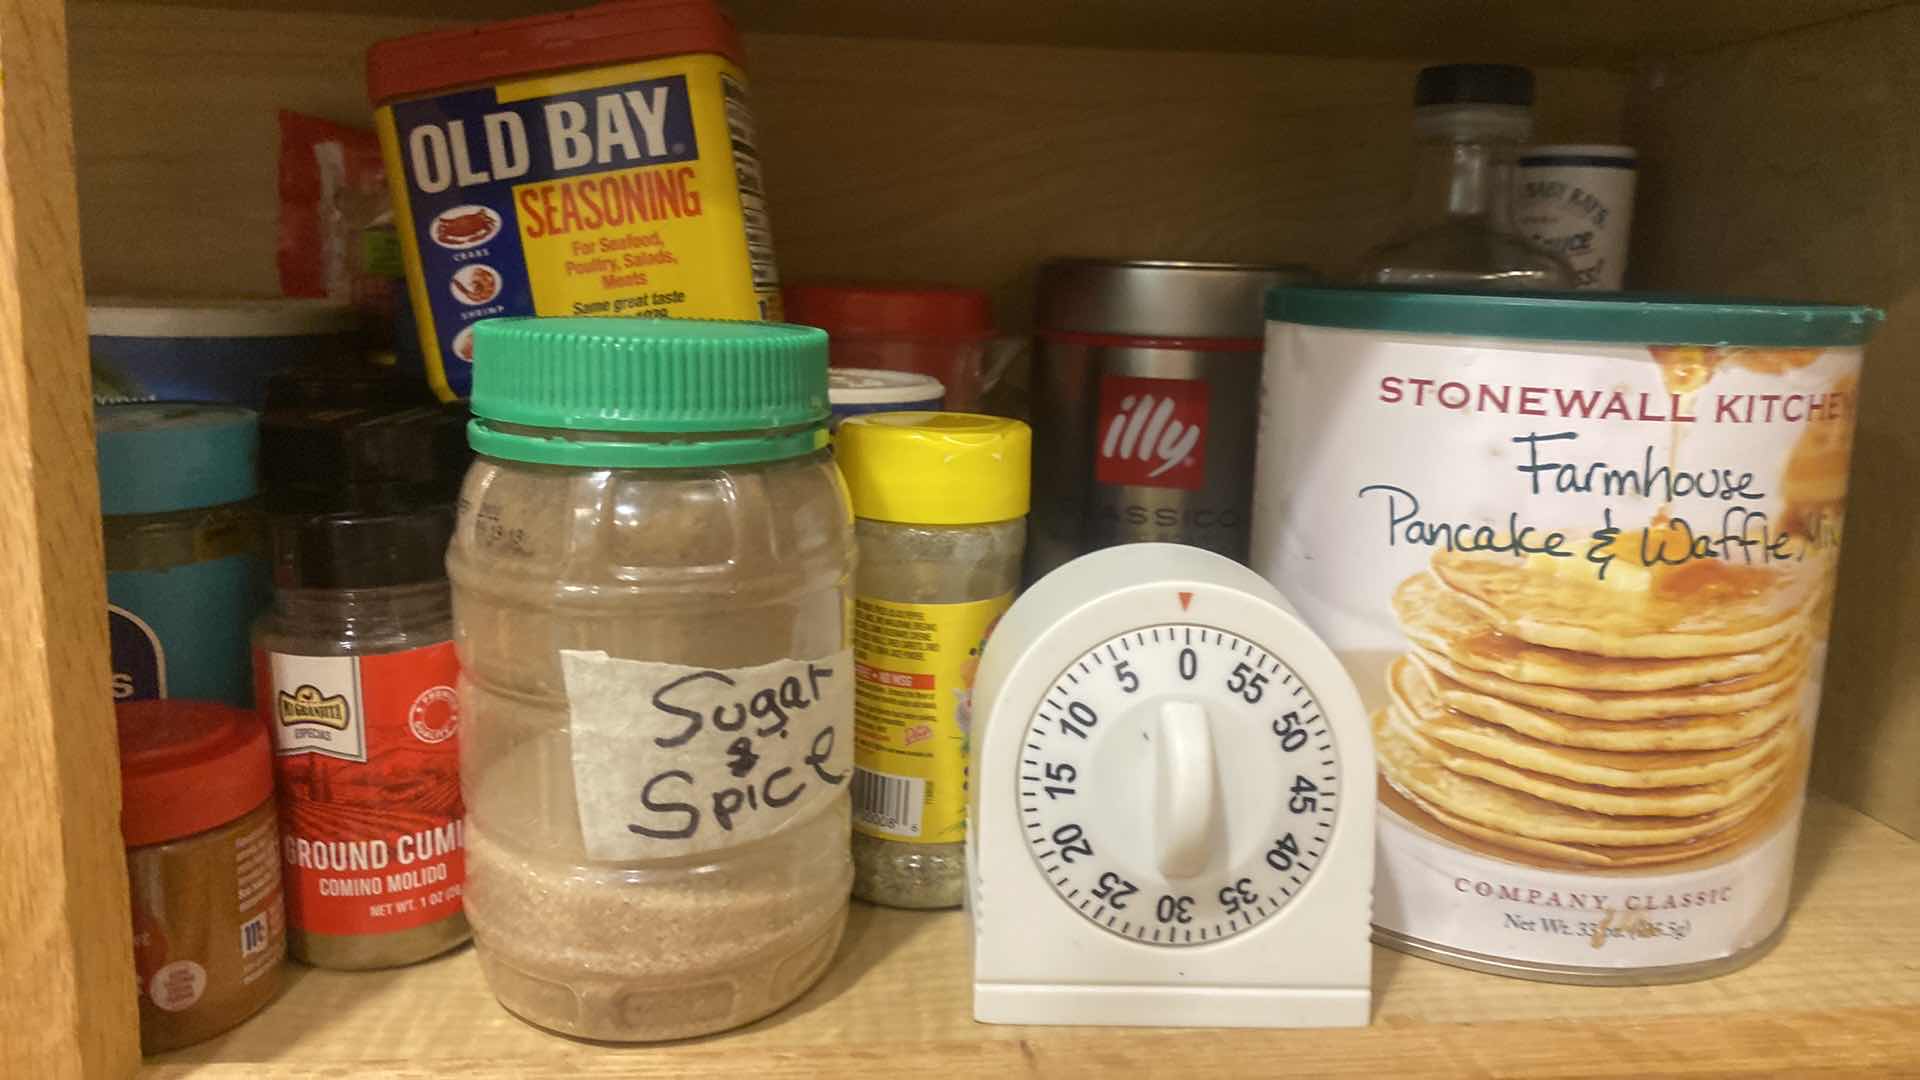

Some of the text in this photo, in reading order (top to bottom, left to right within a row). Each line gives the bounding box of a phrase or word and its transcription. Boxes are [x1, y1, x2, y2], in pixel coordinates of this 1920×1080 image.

[410, 87, 668, 194] OLD BAY
[520, 167, 703, 239] SEASONING
[565, 249, 679, 276] Poultry, Salads,
[572, 232, 665, 257] For Seafood,
[603, 272, 648, 290] Meats
[573, 290, 686, 315] Same great taste
[1381, 377, 1846, 424] STONEWALL KITCHE
[1103, 394, 1200, 478] illy
[1512, 432, 1765, 502] Farmhouse
[1359, 484, 1574, 558] Pancake
[1586, 508, 1617, 581] &
[1641, 506, 1794, 568] Waffle
[1114, 660, 1140, 693] 5
[1179, 648, 1198, 681] 0
[1227, 662, 1269, 704] 55
[652, 664, 833, 748] Sugar
[1059, 701, 1098, 740] 10
[1273, 711, 1308, 752] 50
[726, 736, 760, 778] &
[628, 726, 846, 840] Spice
[1045, 762, 1077, 800] 15
[1289, 775, 1318, 814] 45
[284, 833, 389, 872] GROUND
[396, 819, 464, 865] CUMI
[1052, 823, 1094, 864] 20
[1266, 832, 1299, 871] 40
[319, 863, 448, 897] COMINO MOLIDO
[1091, 871, 1139, 911] 25
[1218, 878, 1258, 915] 35
[1454, 877, 1734, 911] COMPANY CLASSIC
[369, 904, 393, 918] NET
[396, 899, 416, 913] WT.
[421, 896, 427, 909] 1
[429, 891, 444, 906] OZ
[1156, 895, 1195, 924] 30
[1504, 912, 1536, 934] Net
[1539, 918, 1570, 936] Wt.
